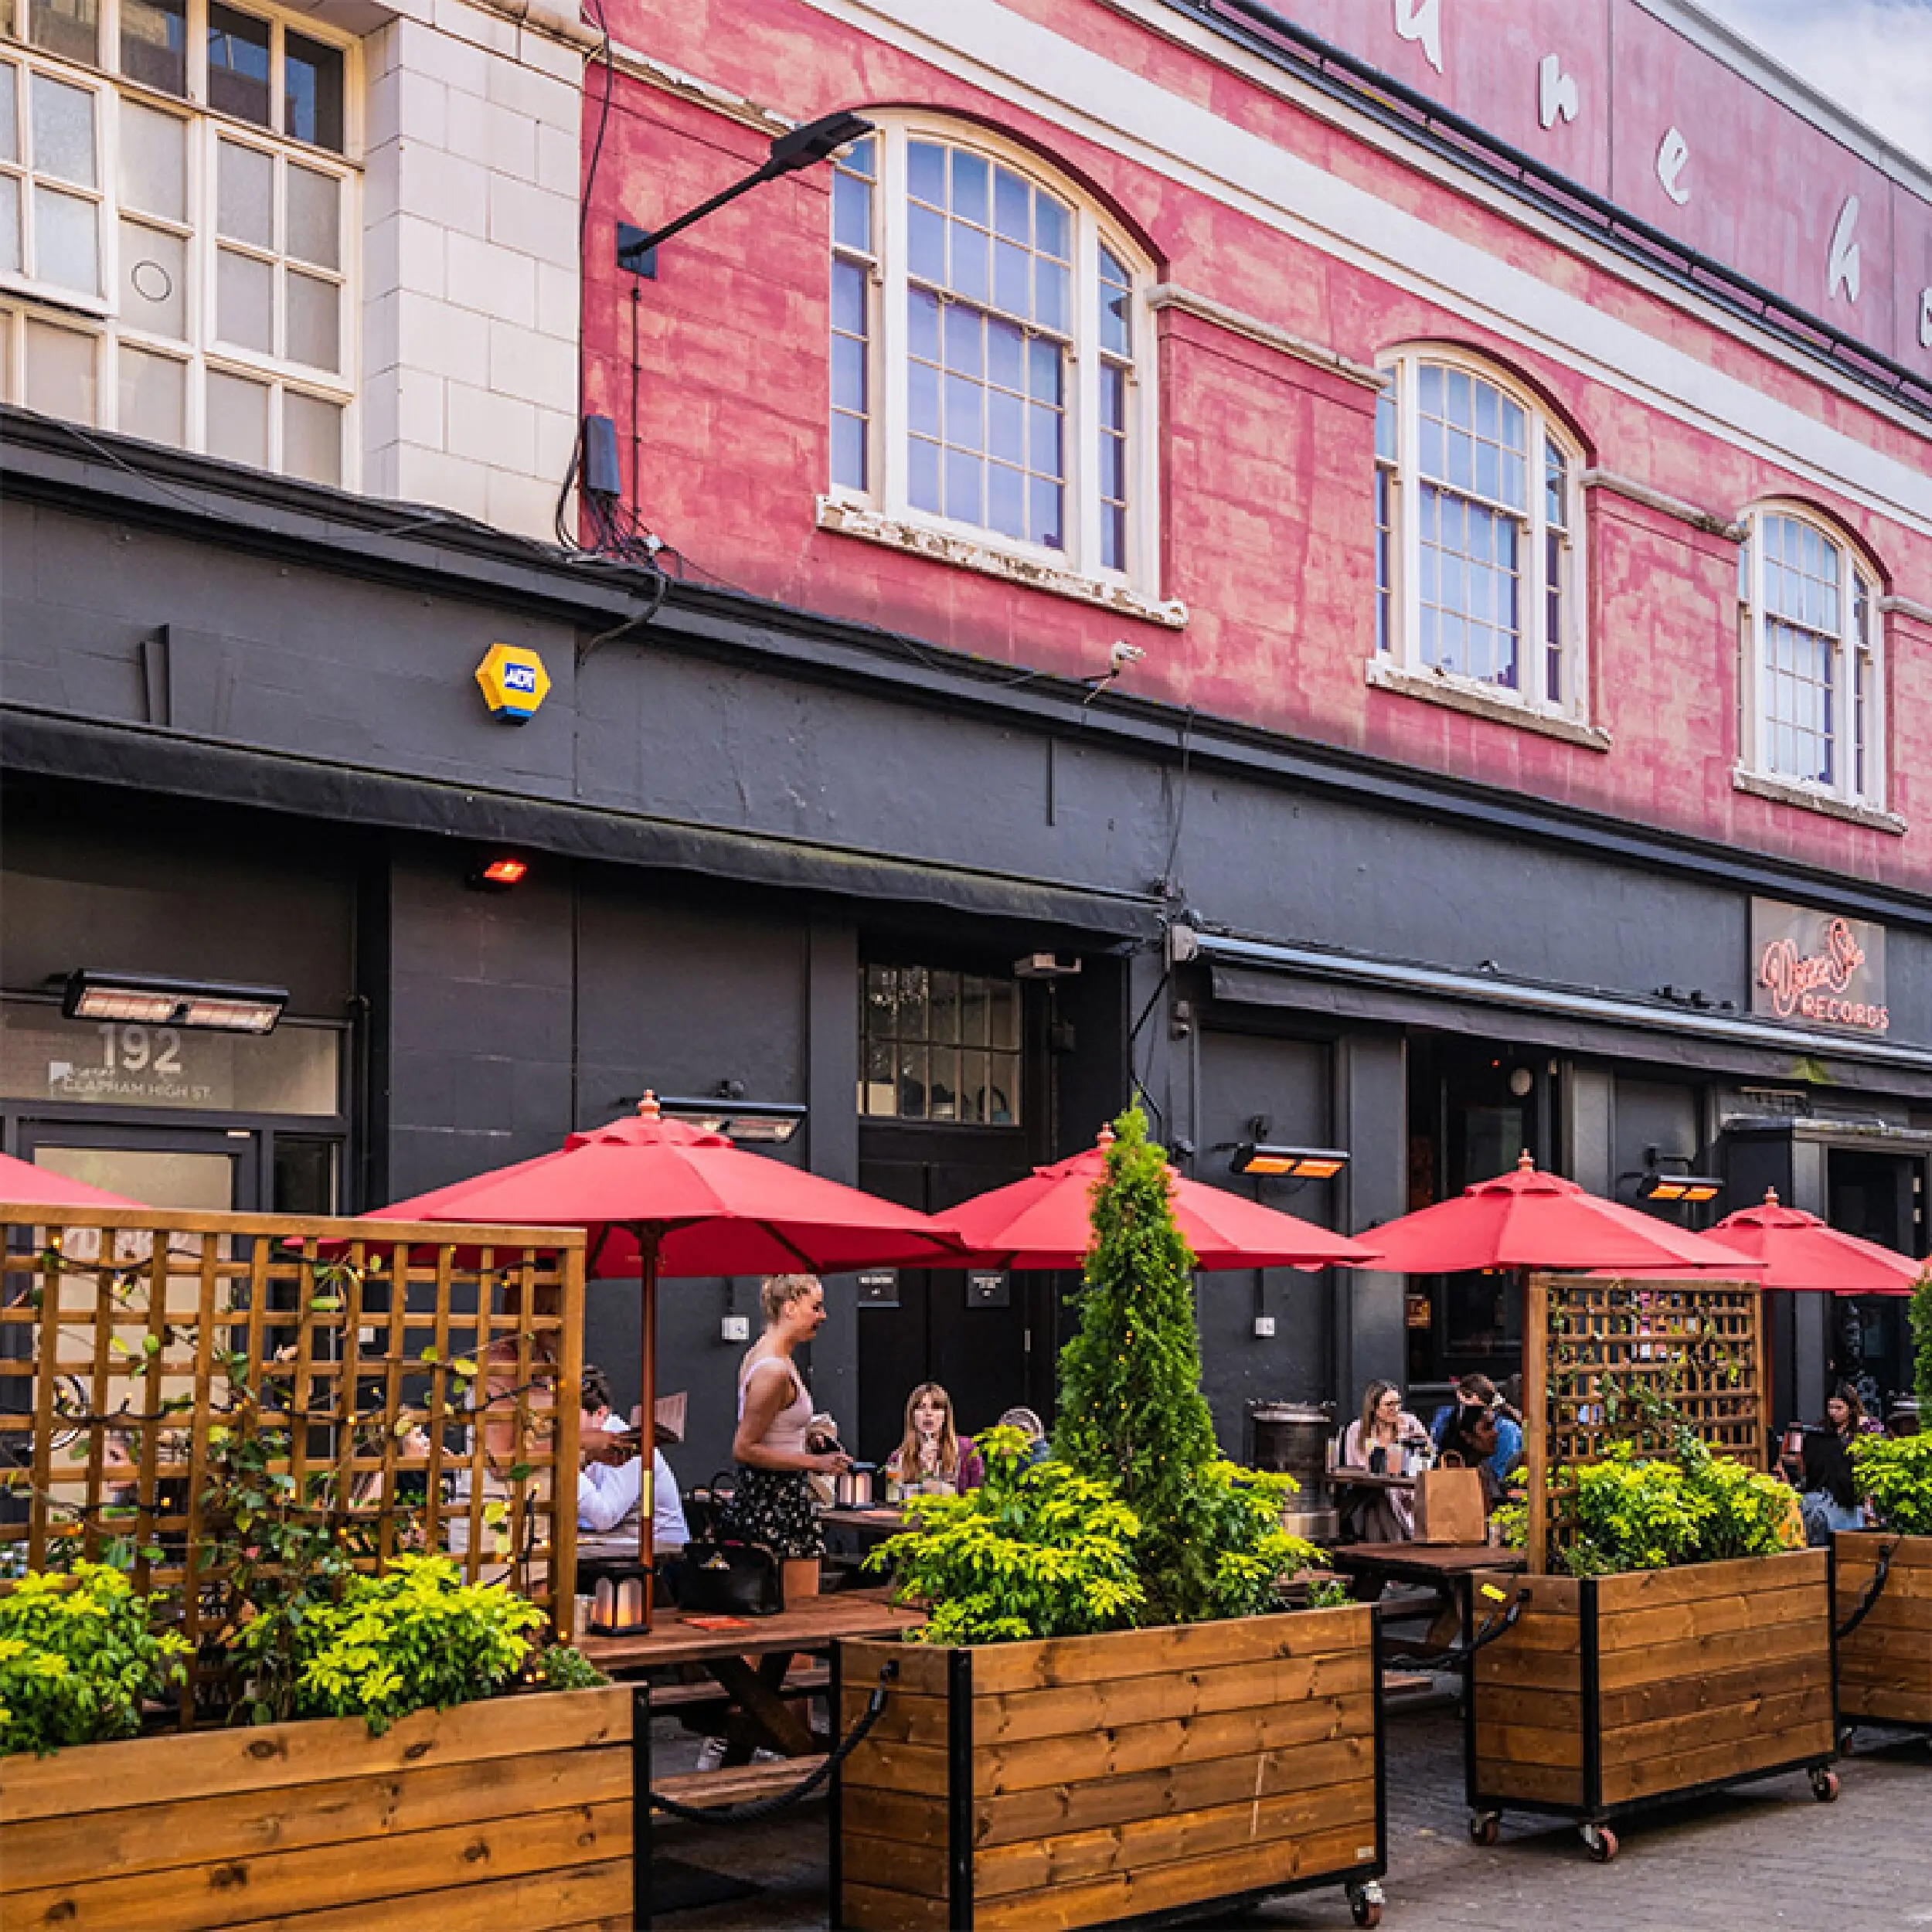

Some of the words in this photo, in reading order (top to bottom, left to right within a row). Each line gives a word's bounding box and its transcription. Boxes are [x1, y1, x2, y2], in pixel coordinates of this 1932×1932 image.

[1801, 995, 1890, 1029] RECORDS
[97, 1022, 182, 1072] 192
[63, 1077, 144, 1096] CLAPHAM
[148, 1083, 188, 1097] HIGH
